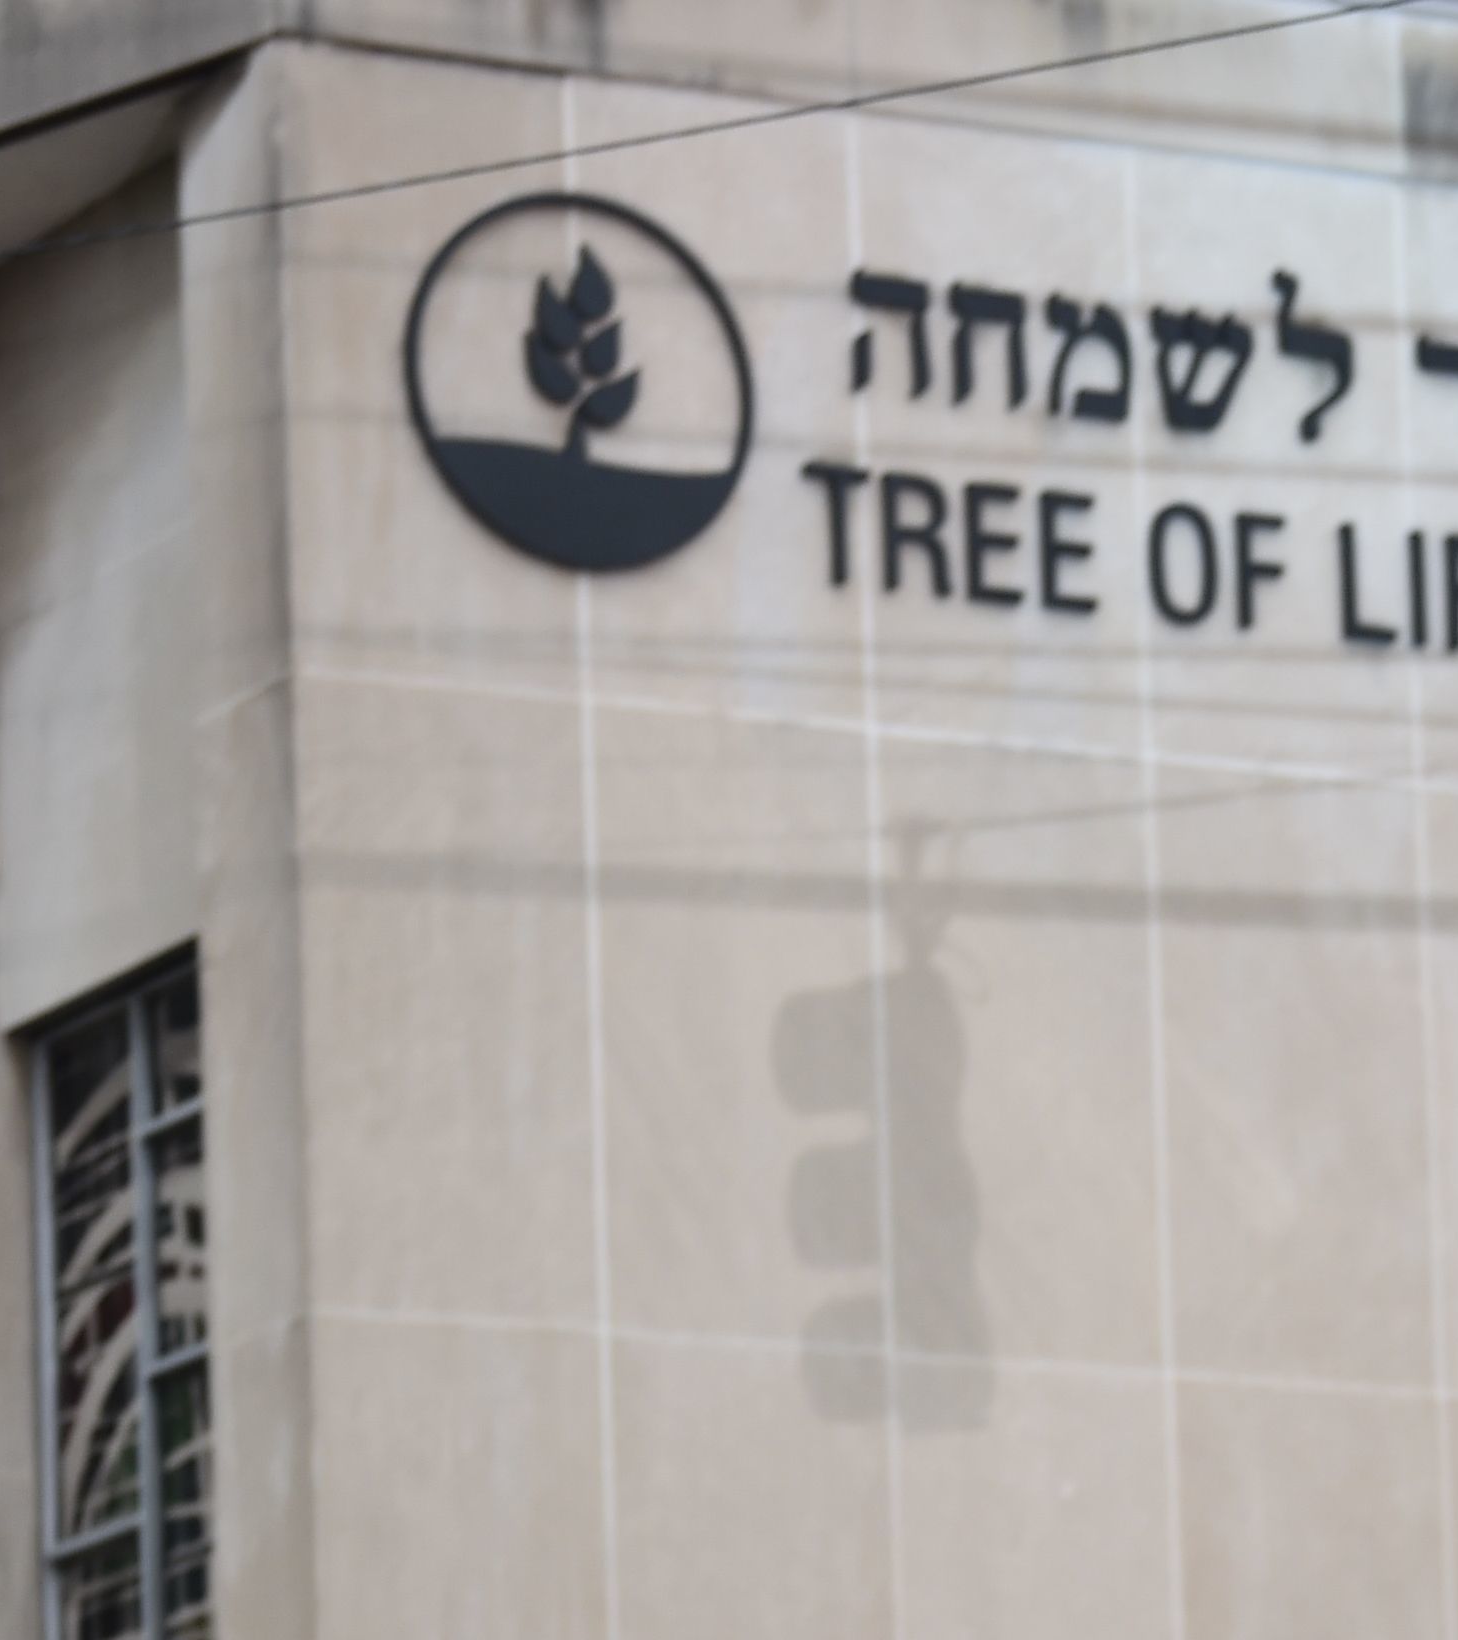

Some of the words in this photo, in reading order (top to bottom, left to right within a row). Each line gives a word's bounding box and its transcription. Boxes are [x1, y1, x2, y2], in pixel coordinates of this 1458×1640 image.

[847, 269, 1353, 444] לשמחה
[800, 460, 1098, 616] TREE
[1147, 502, 1286, 631] OF
